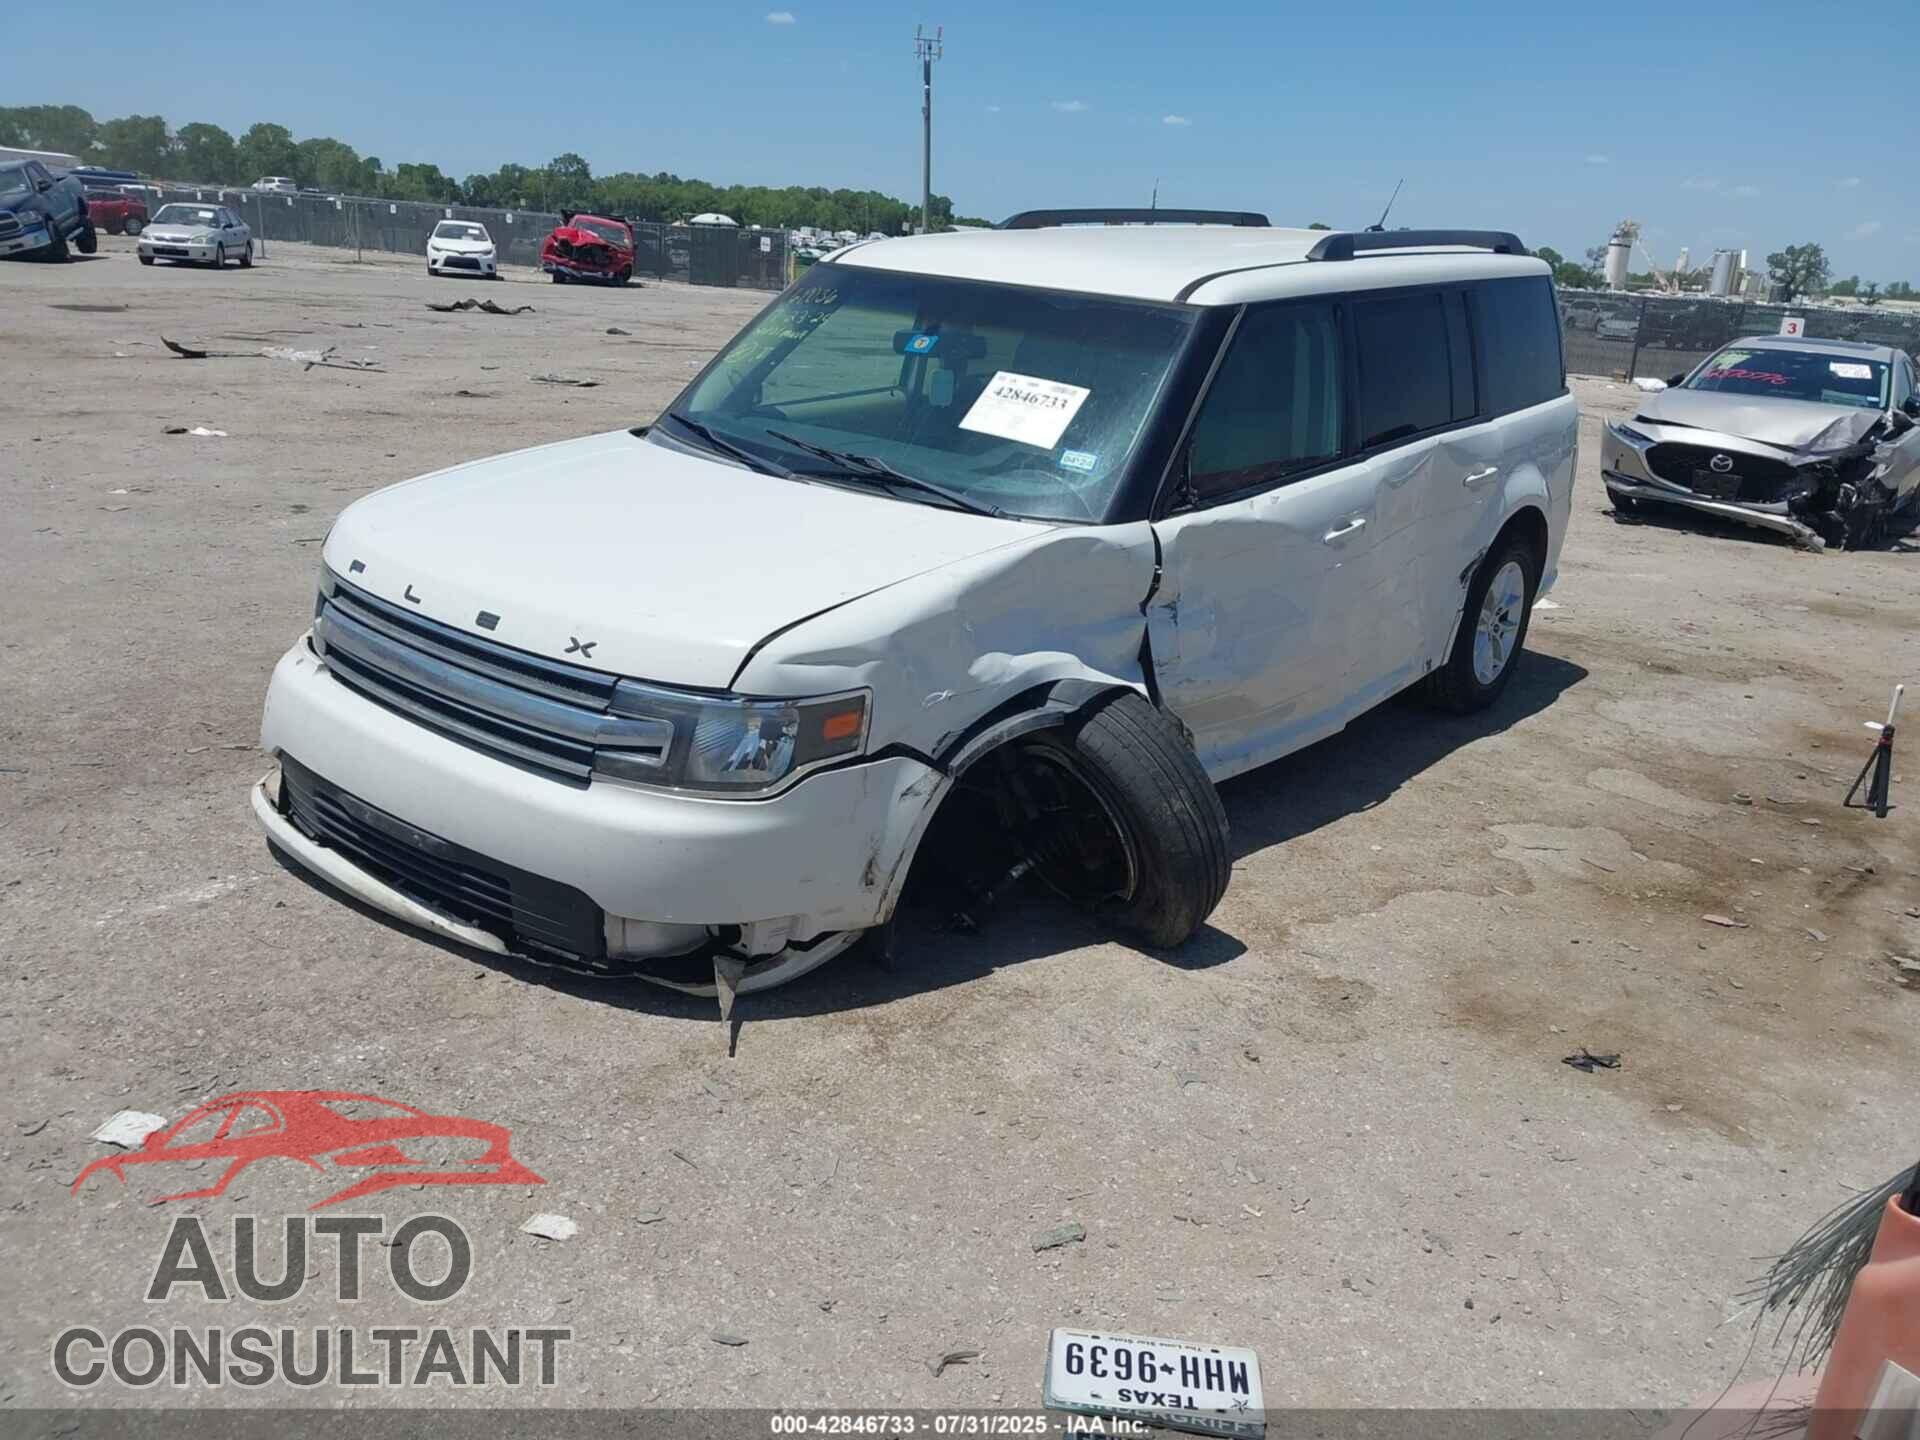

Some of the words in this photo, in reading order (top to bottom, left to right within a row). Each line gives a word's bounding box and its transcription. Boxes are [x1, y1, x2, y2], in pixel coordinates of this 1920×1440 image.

[1787, 322, 1798, 335] 3
[994, 385, 1069, 410] 42846733
[1117, 1388, 1200, 1411] TEXAS
